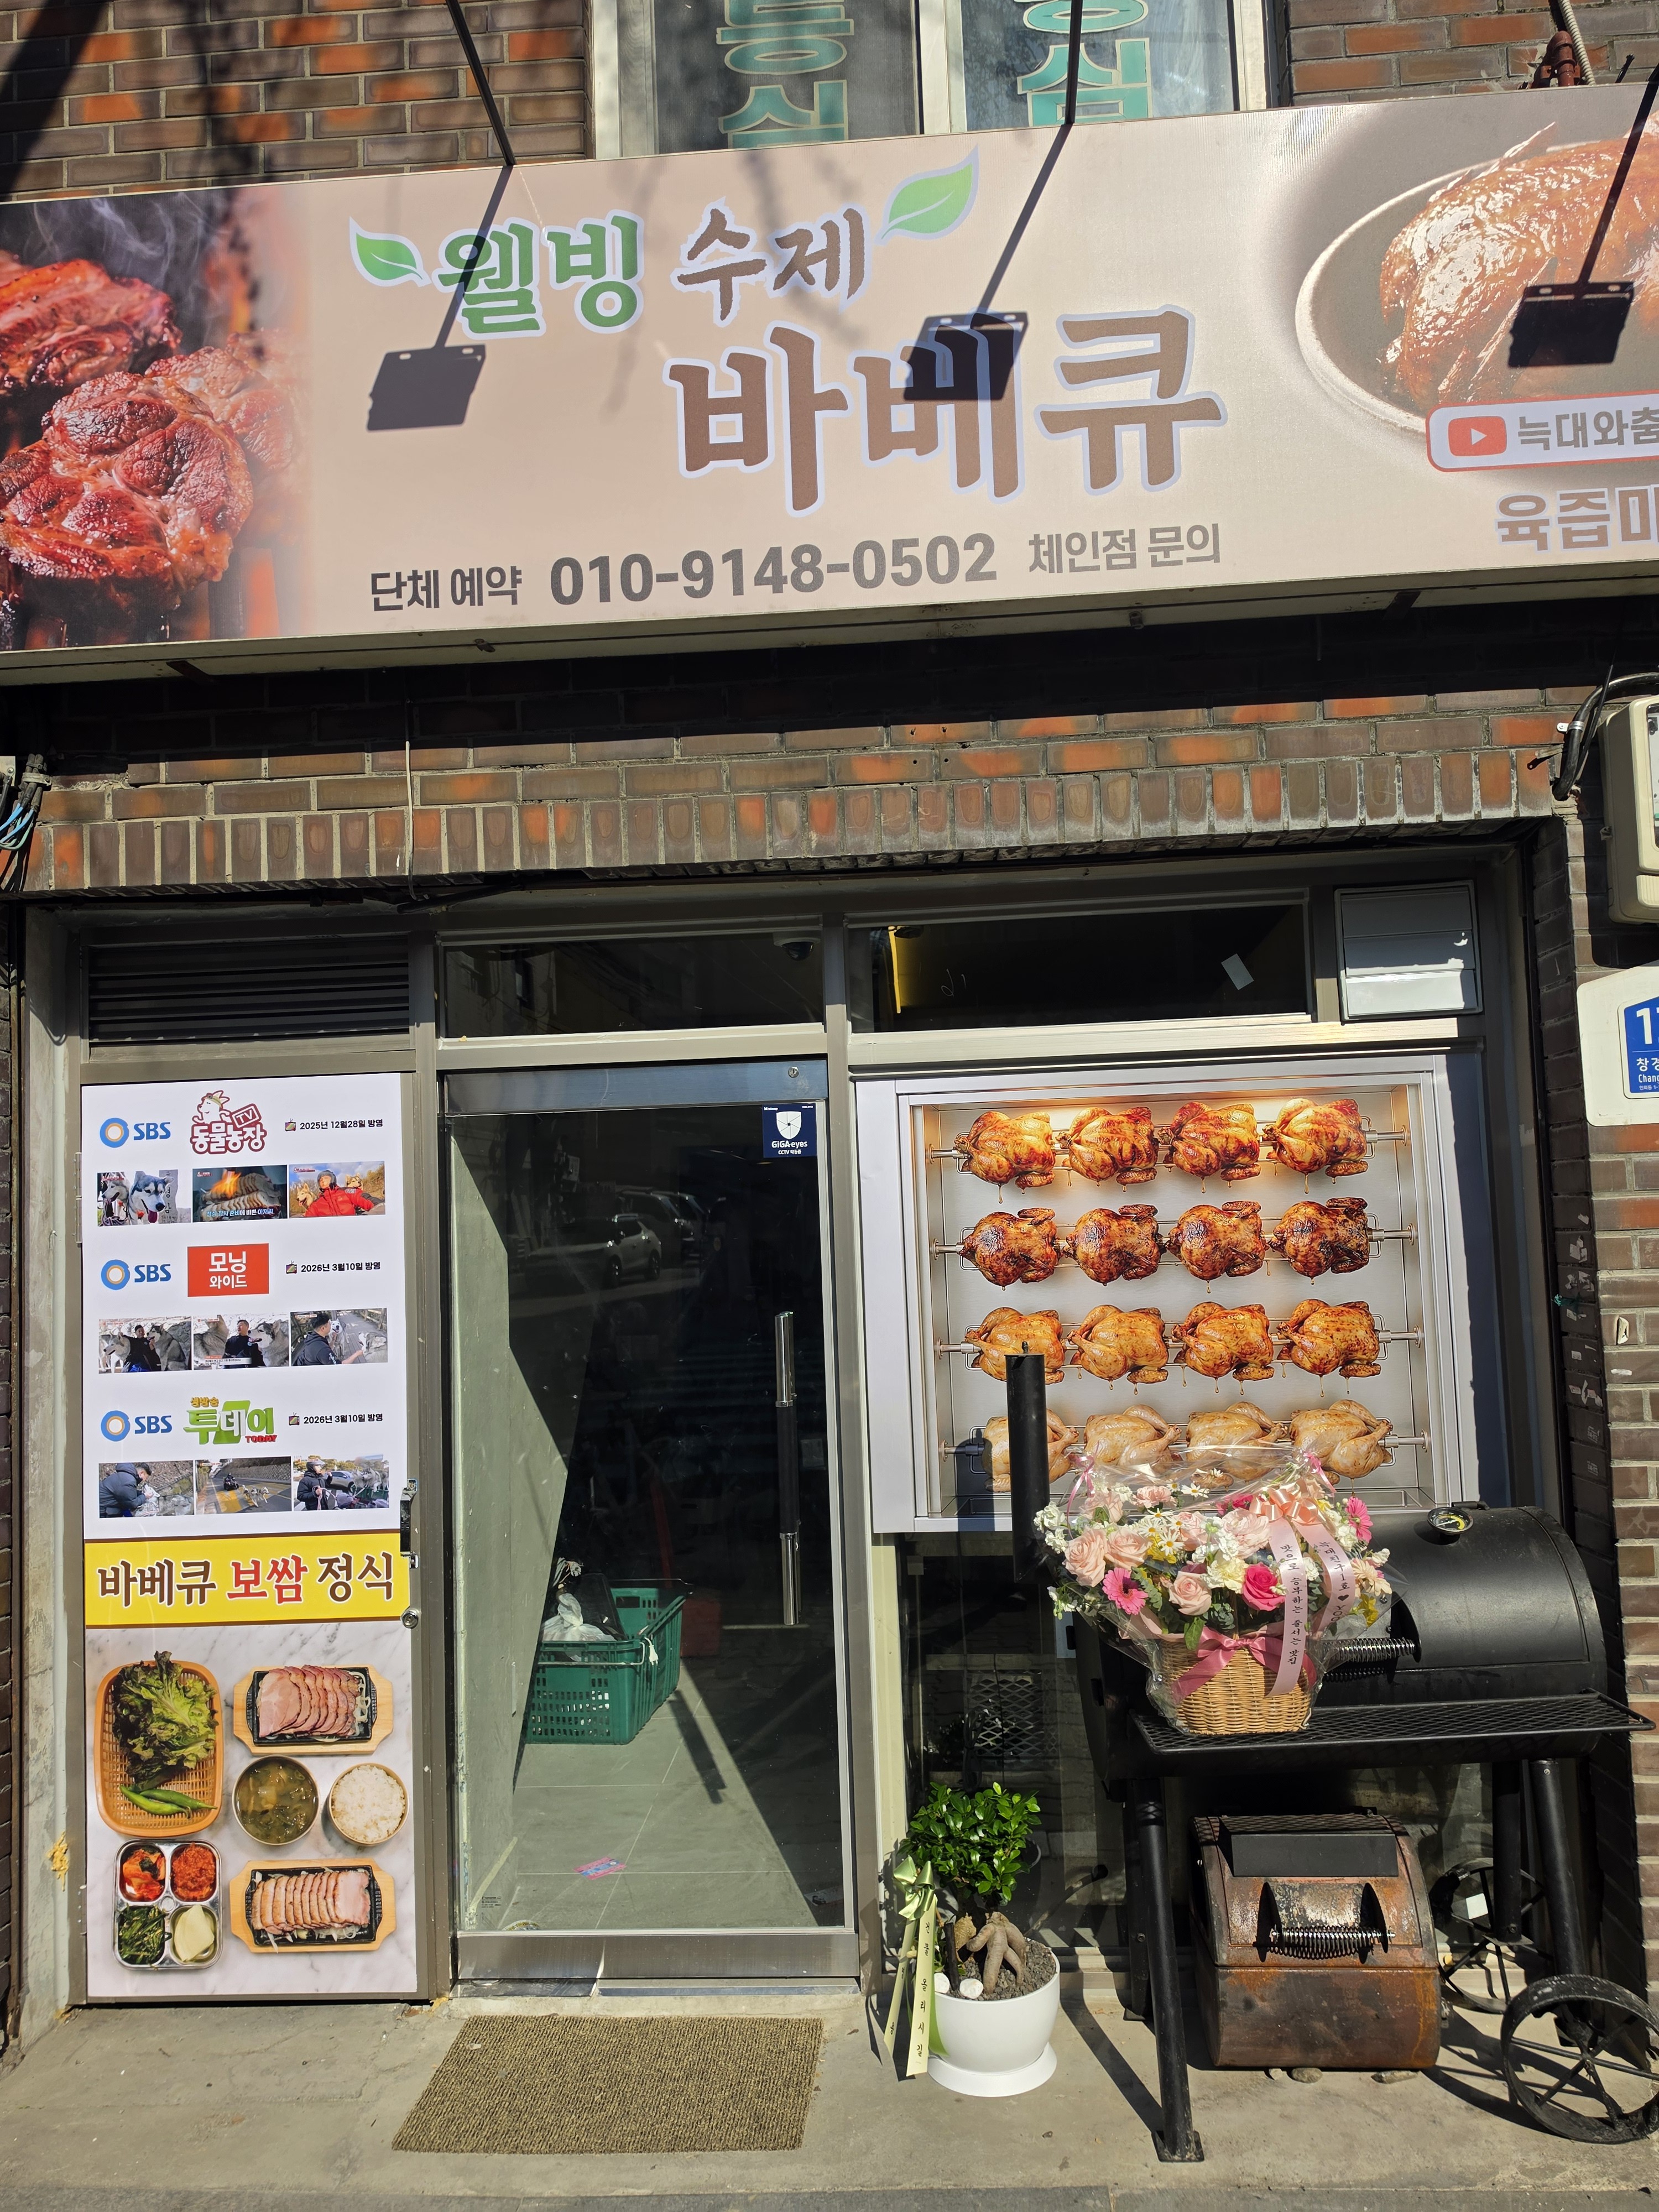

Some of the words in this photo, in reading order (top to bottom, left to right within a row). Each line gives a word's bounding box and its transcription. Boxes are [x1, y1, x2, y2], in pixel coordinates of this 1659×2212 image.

[438, 215, 637, 334] 웰빙
[677, 208, 864, 321] 수제
[669, 310, 1222, 511] 바베큐
[371, 570, 440, 611] 단체
[451, 565, 522, 606] 예약
[550, 533, 997, 606] 010-9148-0502
[1029, 529, 1137, 573] 체인점
[1148, 523, 1220, 567] 문의
[1636, 1007, 1659, 1045] 1
[236, 1109, 254, 1123] TV
[300, 1121, 328, 1130] 2025년
[331, 1120, 366, 1129] 12월28일
[368, 1119, 384, 1128] 방영
[133, 1122, 171, 1140] SBS
[192, 1124, 265, 1152] 동물농장
[208, 1251, 247, 1273] 모닝
[301, 1264, 330, 1272] 2026년
[332, 1262, 363, 1271] 3월10일
[365, 1261, 381, 1270] 방영
[134, 1264, 171, 1282] SBS
[209, 1274, 248, 1289] 와이드
[190, 1397, 219, 1408] 생방송
[134, 1415, 173, 1434] SBS
[183, 1407, 274, 1445] 투데이
[304, 1415, 332, 1424] 2026년
[335, 1414, 366, 1423] 3월10일
[368, 1413, 383, 1422] 방영
[245, 1434, 278, 1443] TODAY
[1280, 1544, 1300, 1571] 맛으로
[97, 1558, 216, 1607] 바베큐
[227, 1554, 307, 1604] 보쌈
[317, 1552, 393, 1602] 정식
[1290, 1577, 1303, 1614] 승부하는
[1290, 1620, 1303, 1646] 줄서는
[1287, 1649, 1301, 1665] 맛집
